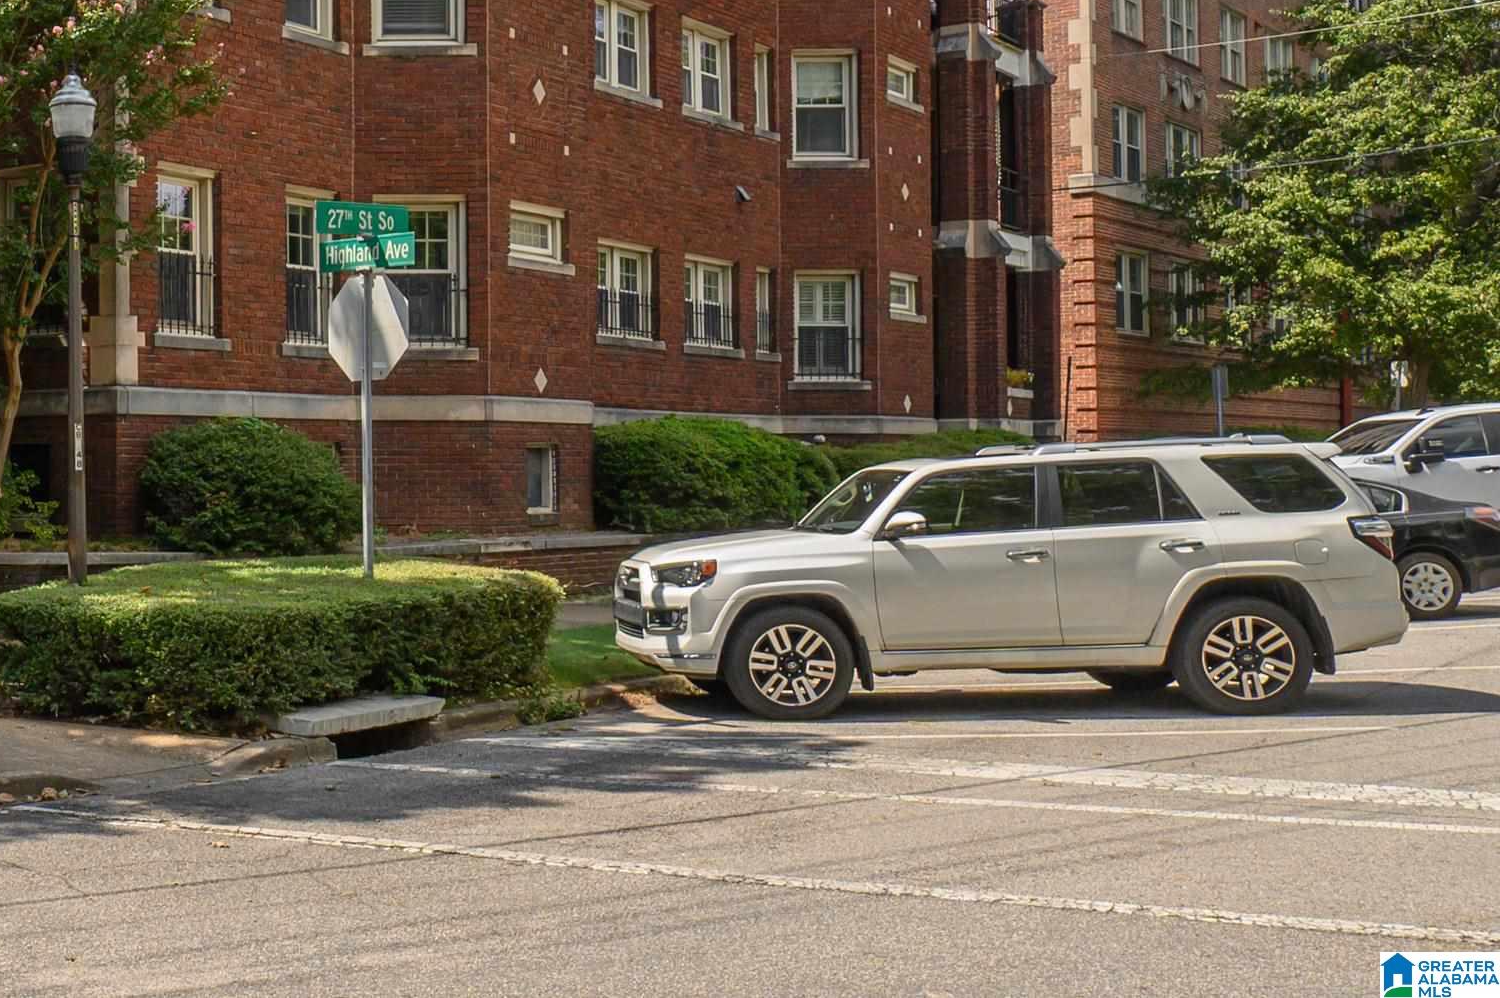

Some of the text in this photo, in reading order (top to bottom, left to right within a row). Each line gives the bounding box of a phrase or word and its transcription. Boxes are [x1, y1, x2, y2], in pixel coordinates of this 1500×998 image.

[358, 210, 373, 230] St
[378, 211, 395, 231] So
[325, 240, 409, 266] Highland Ave
